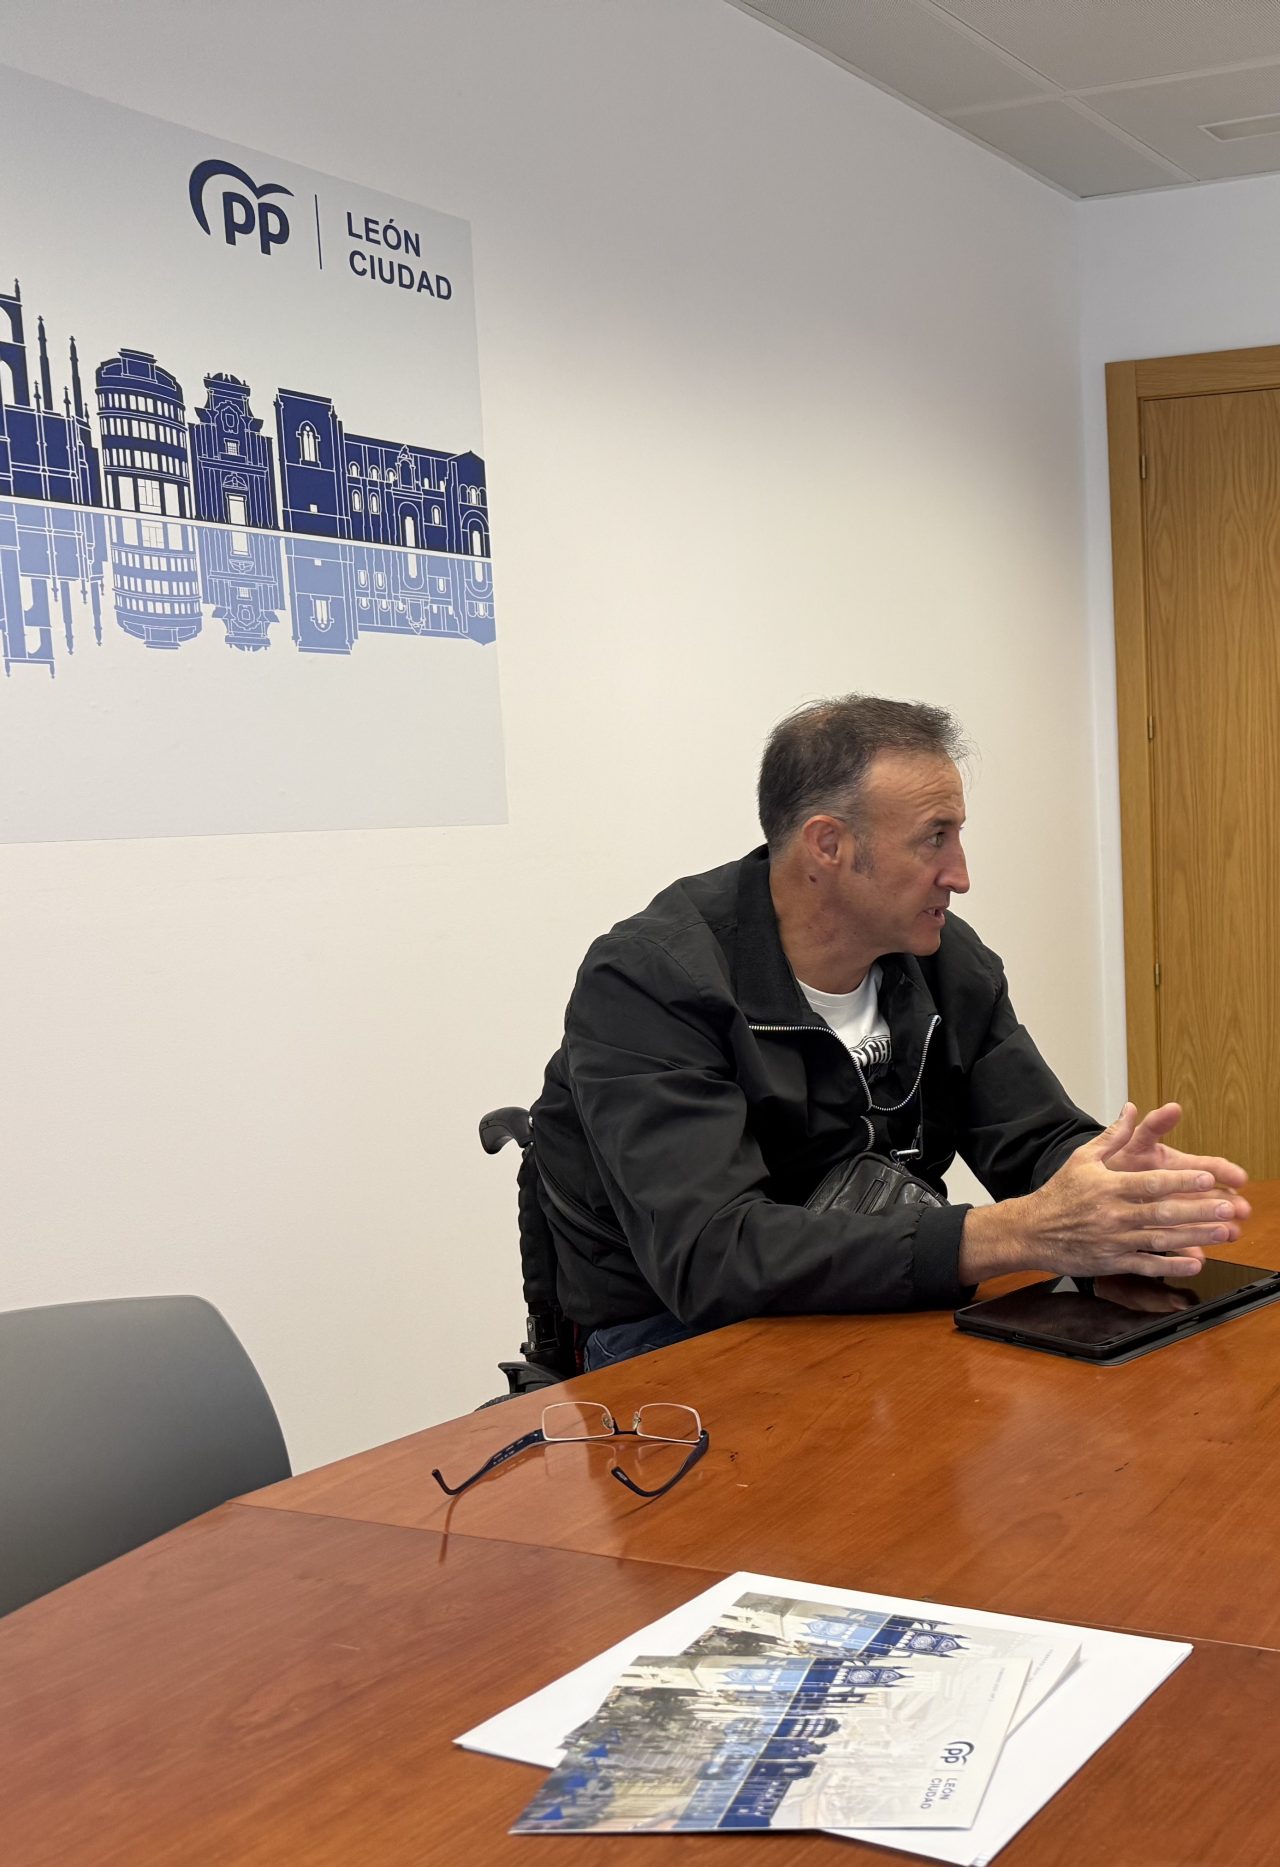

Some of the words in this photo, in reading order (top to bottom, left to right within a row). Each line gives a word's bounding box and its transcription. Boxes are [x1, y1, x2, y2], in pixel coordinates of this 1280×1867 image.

[346, 211, 421, 258] LEÓN
[349, 250, 452, 301] CIUDAD
[849, 1039, 892, 1067] NCH
[920, 1777, 943, 1810] CIUDAD
